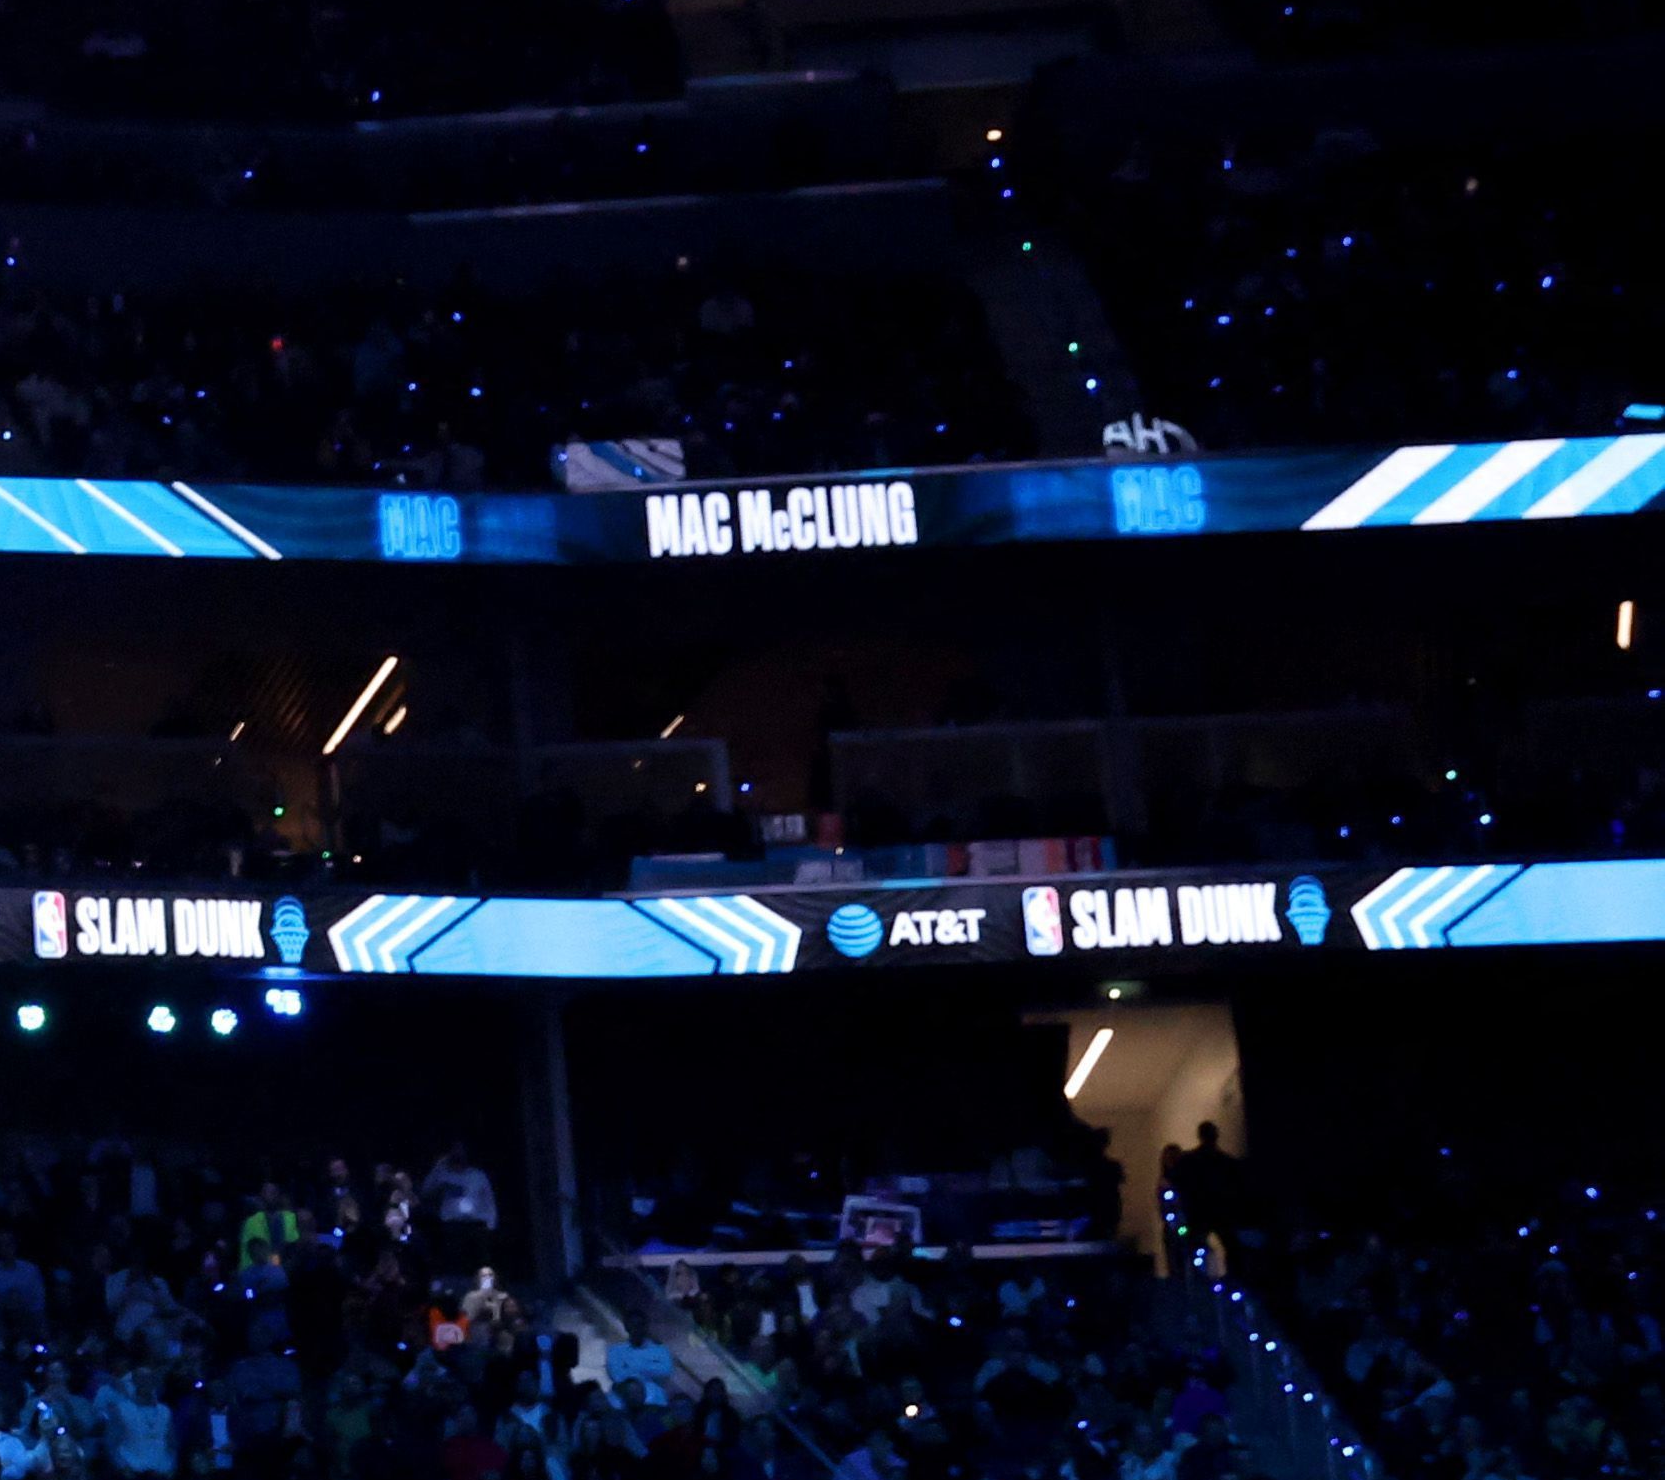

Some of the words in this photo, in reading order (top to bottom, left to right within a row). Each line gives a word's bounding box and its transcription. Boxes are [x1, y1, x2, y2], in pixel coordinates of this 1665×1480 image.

[378, 493, 462, 560] MAC
[646, 490, 733, 559] MAC
[742, 479, 919, 551] McCLUNG
[76, 896, 168, 958] SLAM
[176, 897, 265, 961] DUNK
[888, 907, 986, 946] AT&T
[1072, 887, 1172, 951] SLAM
[1181, 881, 1282, 947] DUNK
